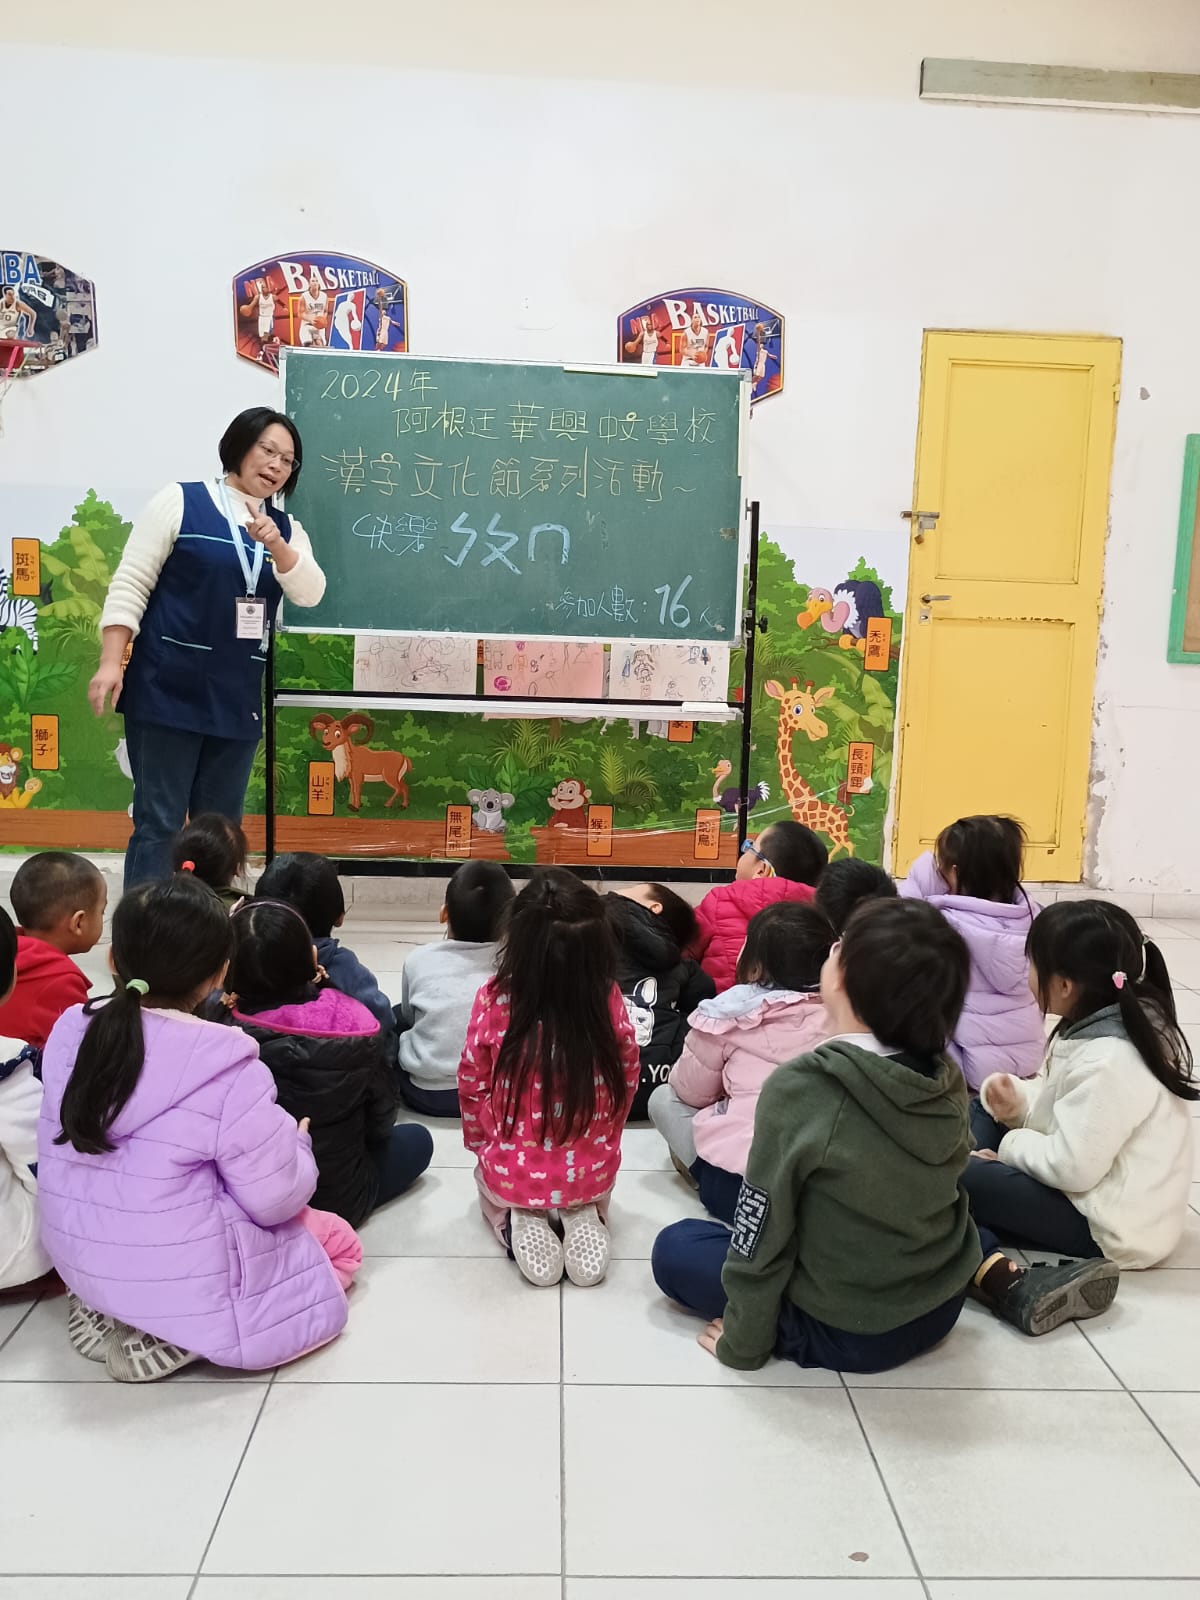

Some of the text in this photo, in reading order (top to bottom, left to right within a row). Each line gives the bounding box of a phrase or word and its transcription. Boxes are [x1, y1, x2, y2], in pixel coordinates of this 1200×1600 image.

[0, 253, 42, 286] BA
[277, 261, 380, 294] BASKETBALL
[662, 299, 759, 330] BASKETBALL
[320, 367, 439, 403] 2024年
[15, 552, 30, 582] 斑馬
[34, 728, 49, 756] 獅子
[311, 774, 325, 801] 山羊
